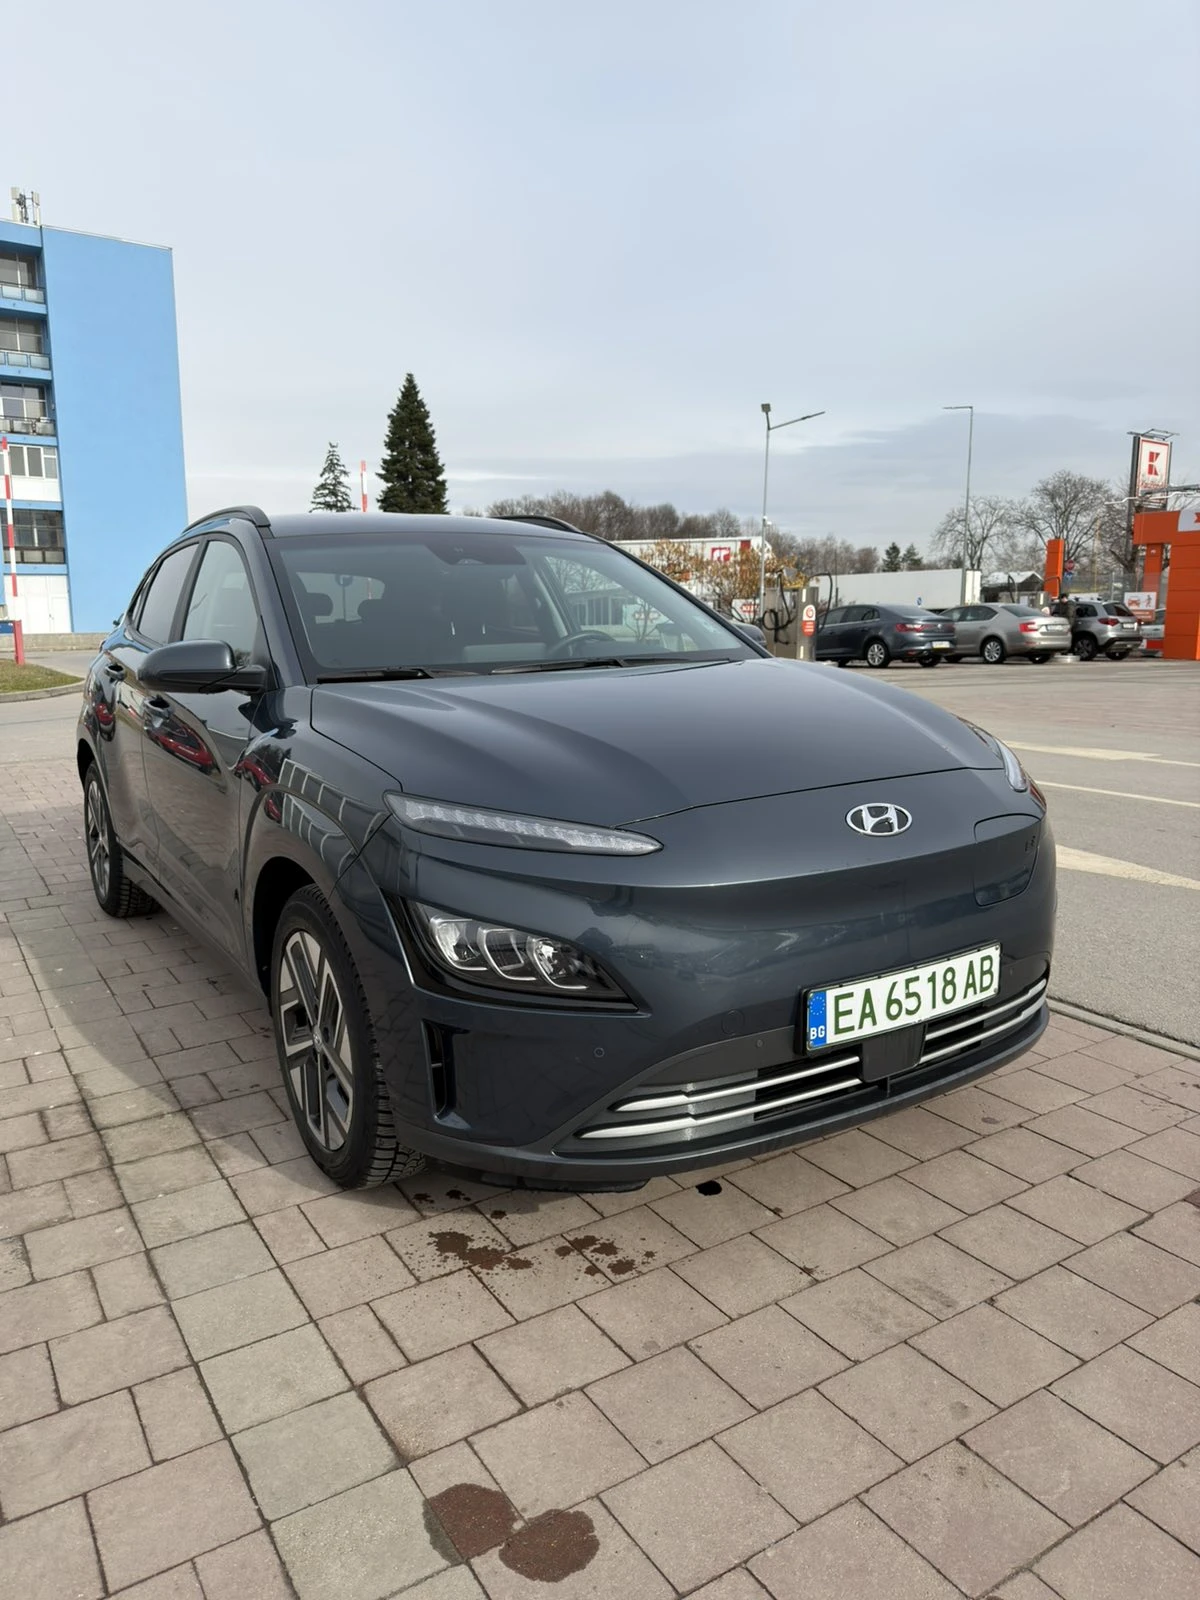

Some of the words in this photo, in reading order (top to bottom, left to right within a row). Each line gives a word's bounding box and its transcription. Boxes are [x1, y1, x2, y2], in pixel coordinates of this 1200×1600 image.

[834, 988, 877, 1035] EA
[886, 966, 957, 1021] 6518
[963, 954, 994, 999] AB
[810, 1026, 825, 1040] BG
